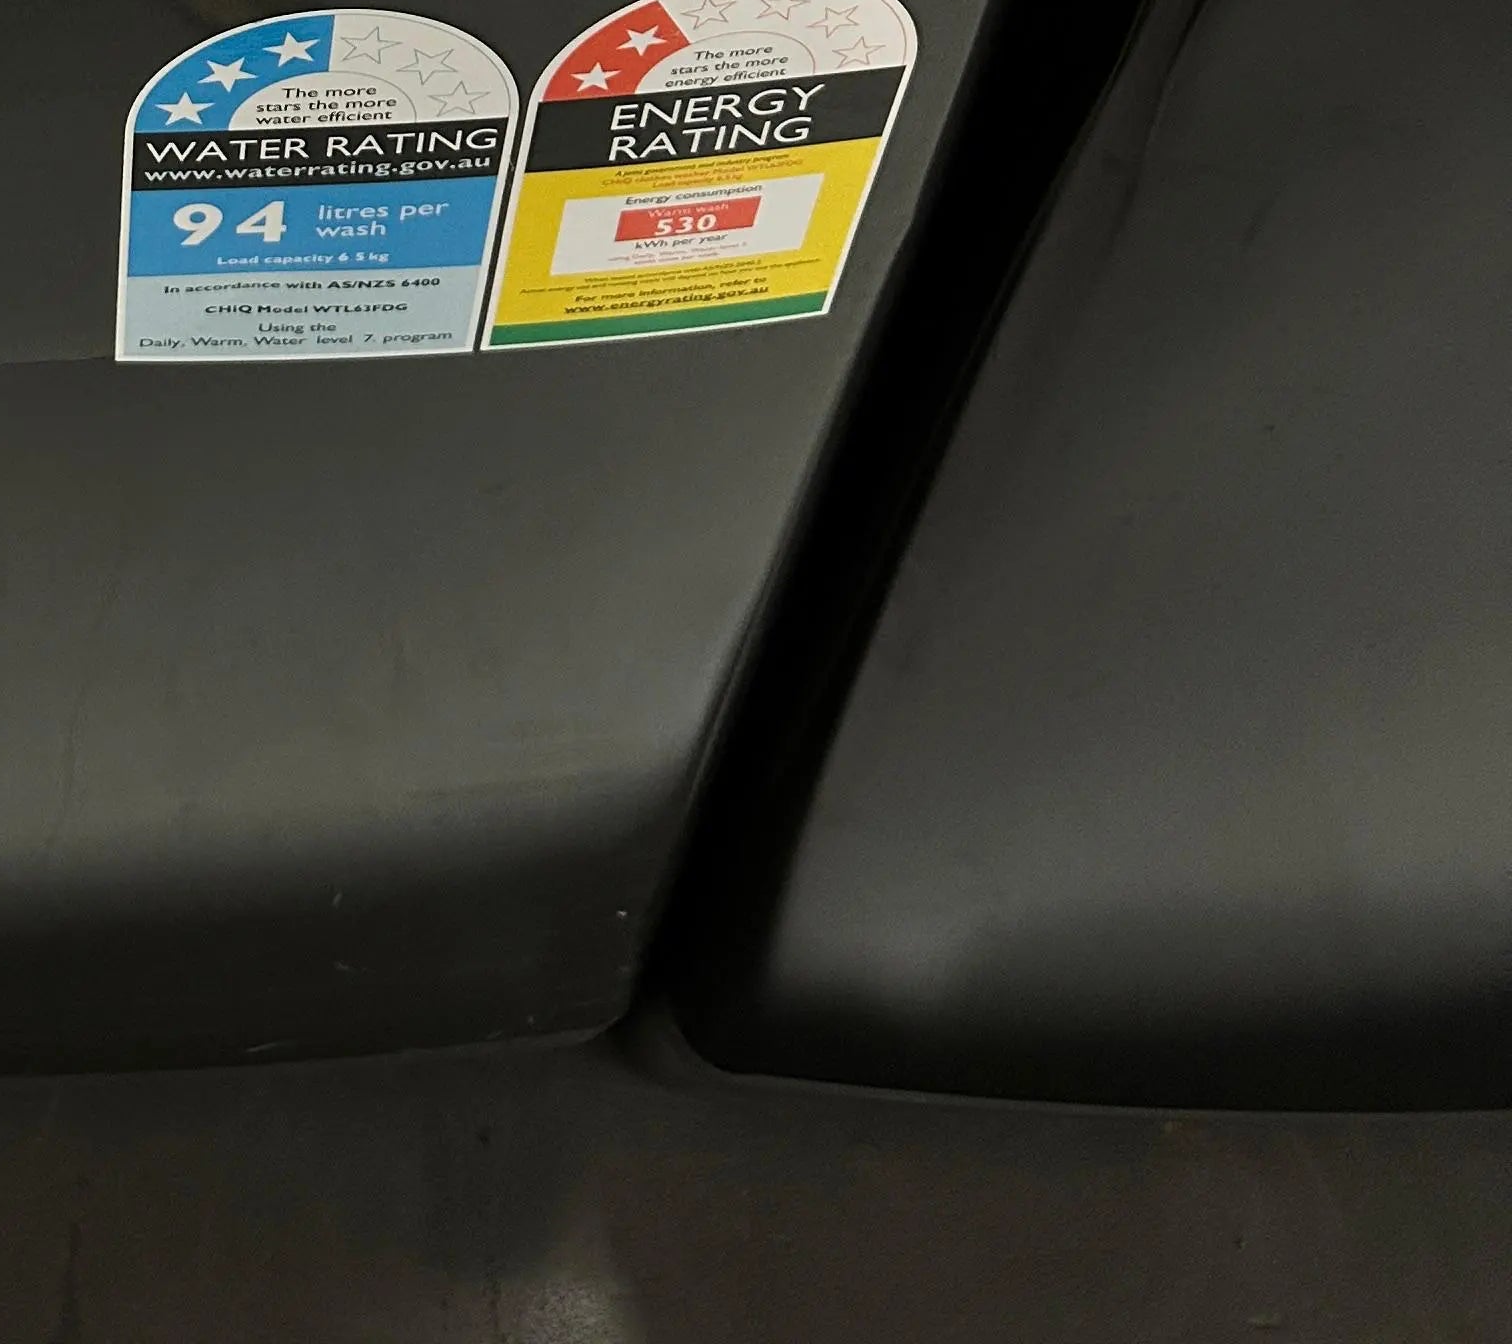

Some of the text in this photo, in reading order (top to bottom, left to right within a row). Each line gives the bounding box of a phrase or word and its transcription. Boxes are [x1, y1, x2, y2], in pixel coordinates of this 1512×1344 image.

[694, 45, 773, 61] The more
[671, 55, 789, 76] stars the more
[664, 67, 787, 89] energy efficient
[282, 86, 377, 99] The more
[256, 98, 397, 113] stars the more
[609, 83, 825, 132] ENERGY
[256, 110, 393, 126] water efficient
[146, 127, 499, 164] WATER RATING
[607, 116, 813, 162] RATING
[144, 155, 491, 183] www.waterrating.gov.au
[624, 184, 763, 206] Energy consumption
[318, 201, 450, 223] litres per
[646, 202, 730, 218] Warm wash
[173, 201, 287, 246] 94
[316, 221, 388, 238] wash
[653, 213, 718, 236] 530
[634, 235, 728, 249] kWh per year
[217, 255, 259, 266] Load
[264, 252, 333, 266] capacity
[163, 277, 441, 295] In accordance with AS/NZS 6400
[575, 294, 597, 302] For
[601, 291, 635, 300] more
[638, 283, 716, 297] information,
[719, 279, 752, 287] refer
[257, 304, 309, 314] Model
[312, 302, 409, 314] WTL63FDG
[563, 286, 770, 315] www.energyrating.gov.au
[258, 322, 337, 335] Using the
[139, 337, 186, 349] Daily,
[190, 335, 248, 348] Warm,
[254, 335, 307, 347] Water
[316, 334, 353, 345] level
[382, 330, 454, 346] program
